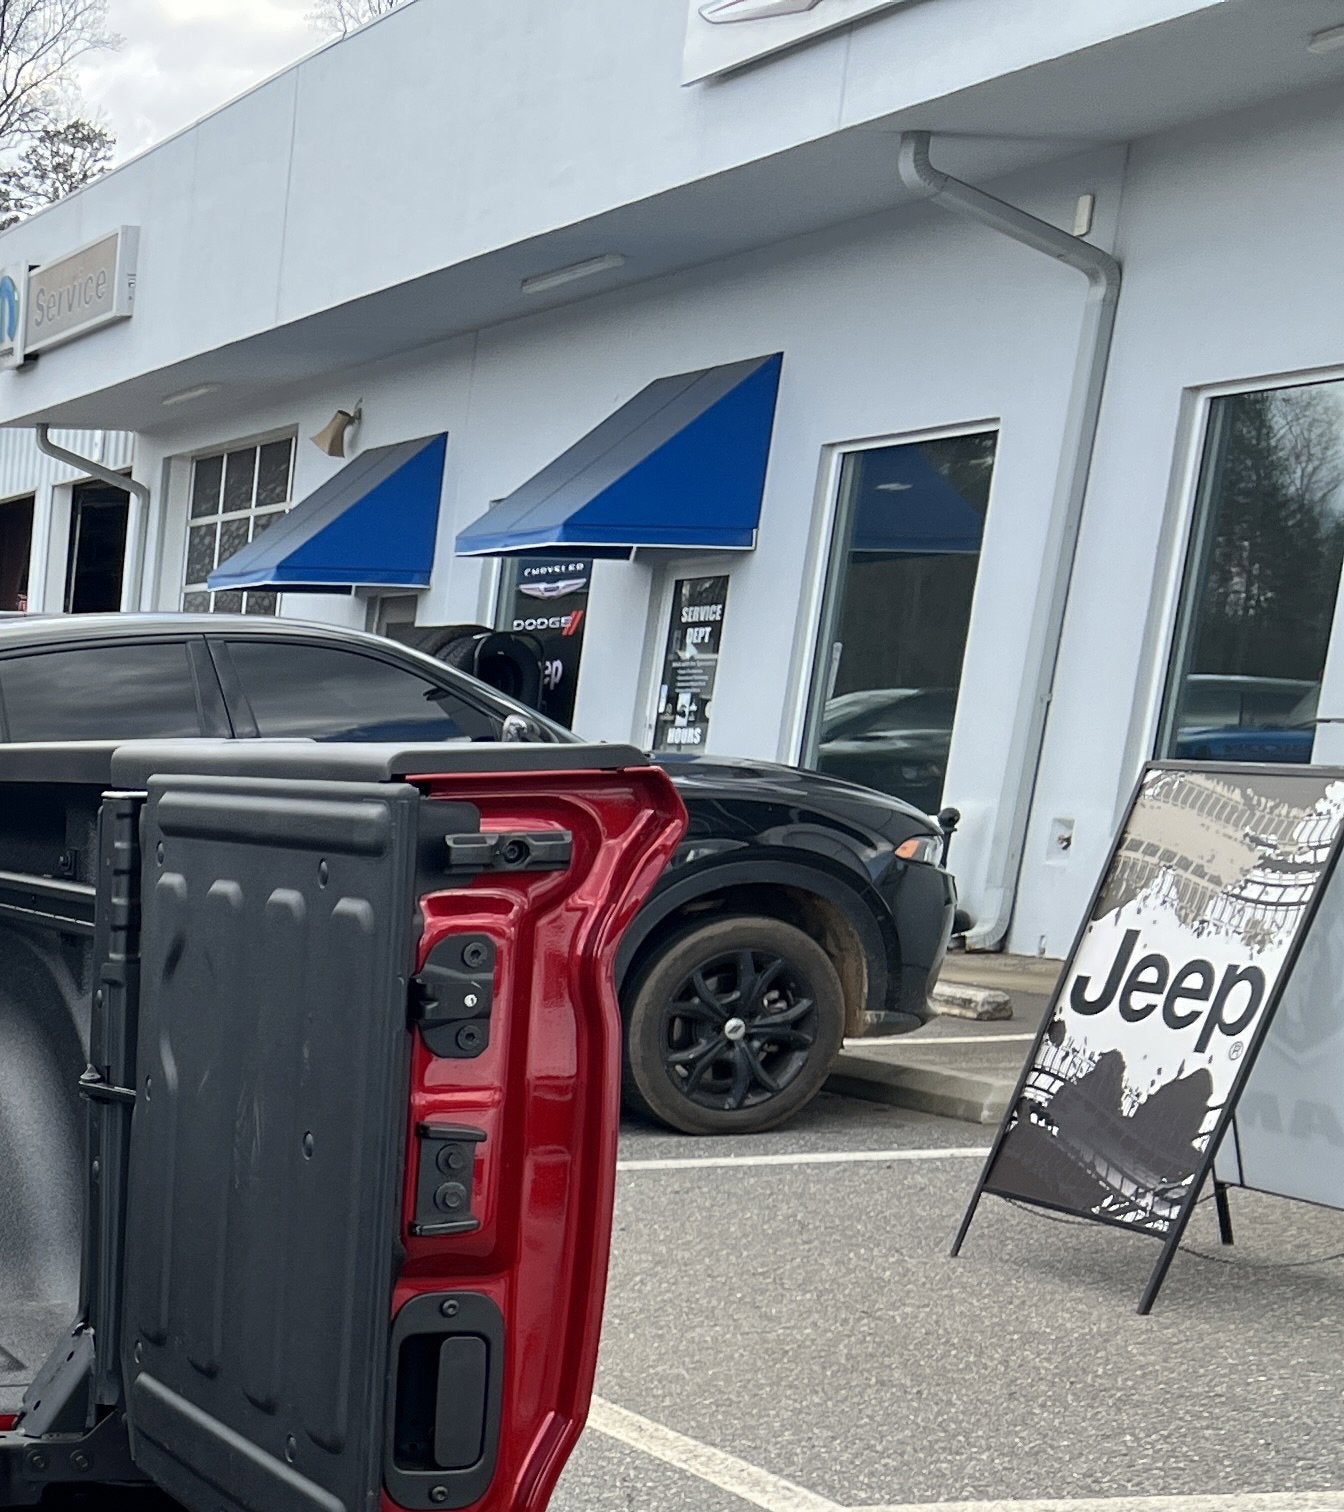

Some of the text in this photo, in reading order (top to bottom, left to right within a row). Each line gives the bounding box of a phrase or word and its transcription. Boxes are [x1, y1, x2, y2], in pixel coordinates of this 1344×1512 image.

[34, 270, 107, 328] Service
[680, 604, 723, 623] SERVICE
[512, 615, 573, 631] DODGE
[686, 626, 712, 644] DEPT
[666, 727, 703, 745] HOURS
[1069, 928, 1267, 1054] Jeep
